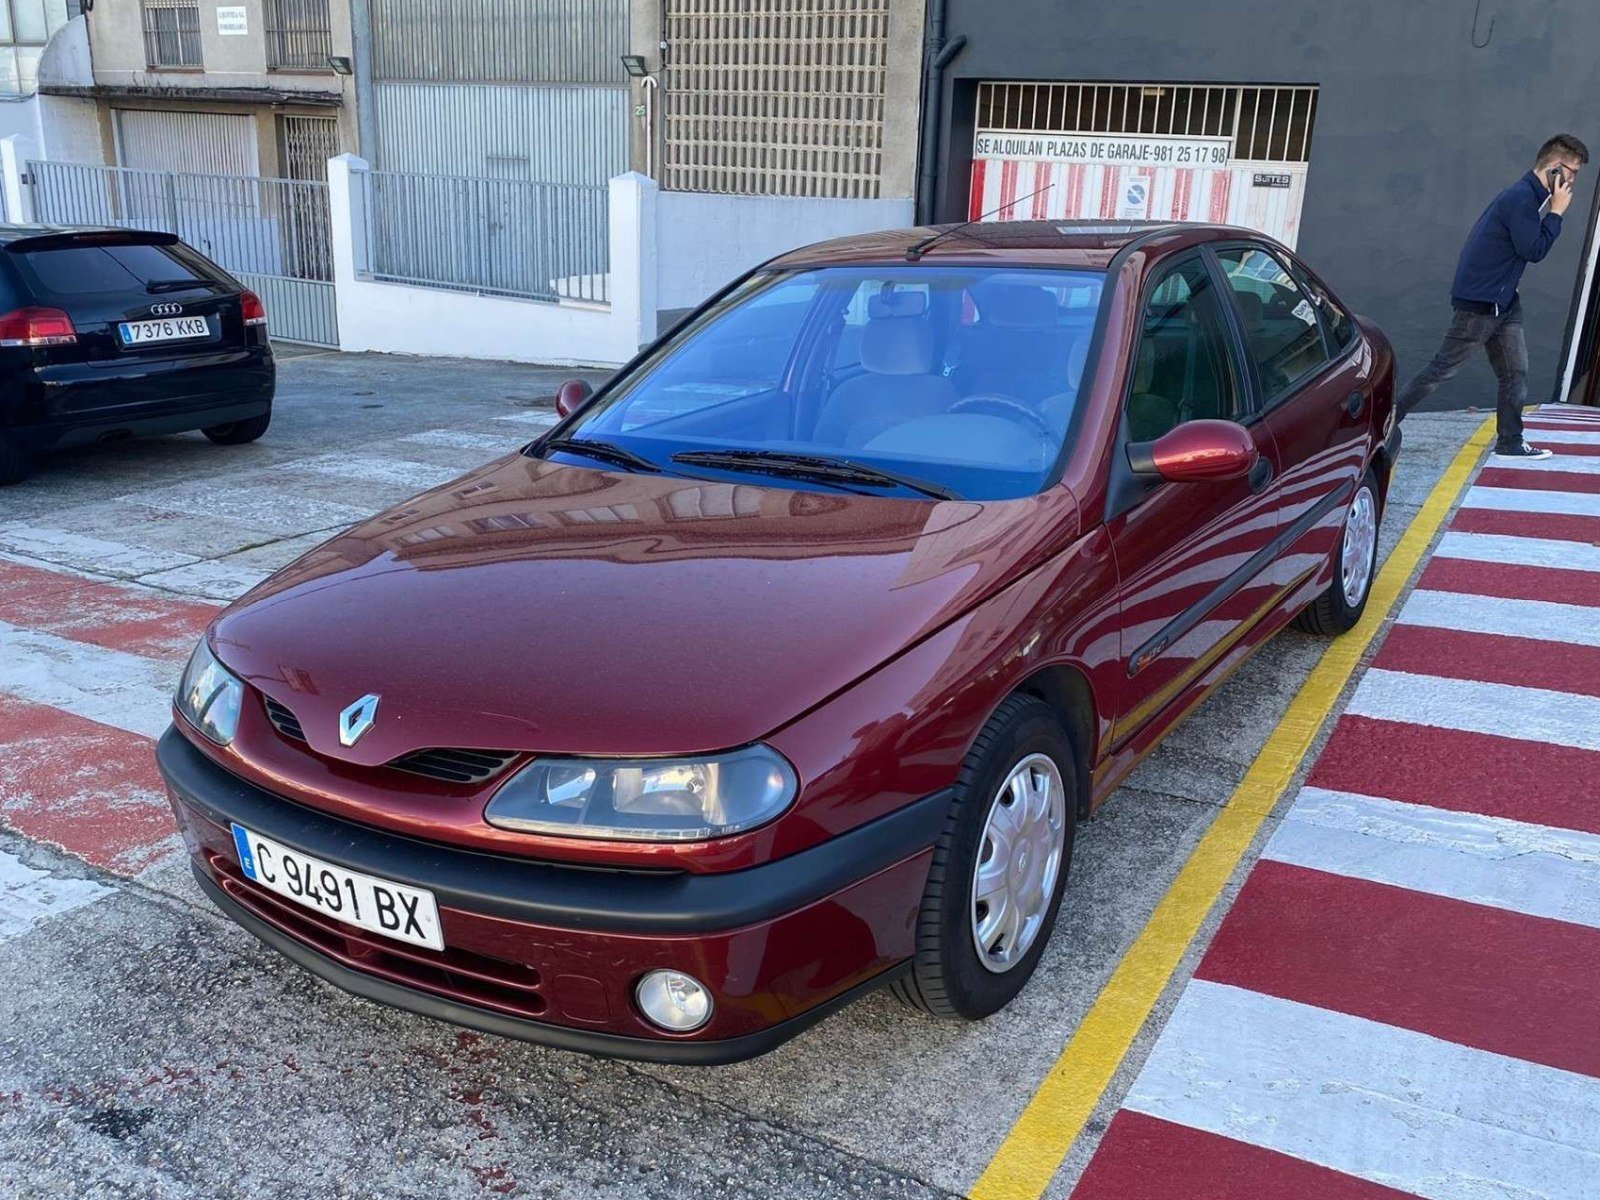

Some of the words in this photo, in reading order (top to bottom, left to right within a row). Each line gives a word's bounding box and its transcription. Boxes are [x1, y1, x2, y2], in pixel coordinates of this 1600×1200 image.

[977, 138, 990, 154] SE
[993, 139, 1042, 155] ALQUILAN
[1047, 141, 1087, 158] PLAZAS
[1090, 143, 1105, 158] DE
[1177, 146, 1191, 162] 25
[1195, 147, 1208, 162] 17
[1211, 147, 1226, 163] 98
[132, 322, 173, 340] 7376
[176, 319, 205, 335] KKB
[244, 857, 251, 869] E
[257, 843, 276, 884] C
[282, 855, 361, 920] 9491
[373, 886, 426, 939] BX
